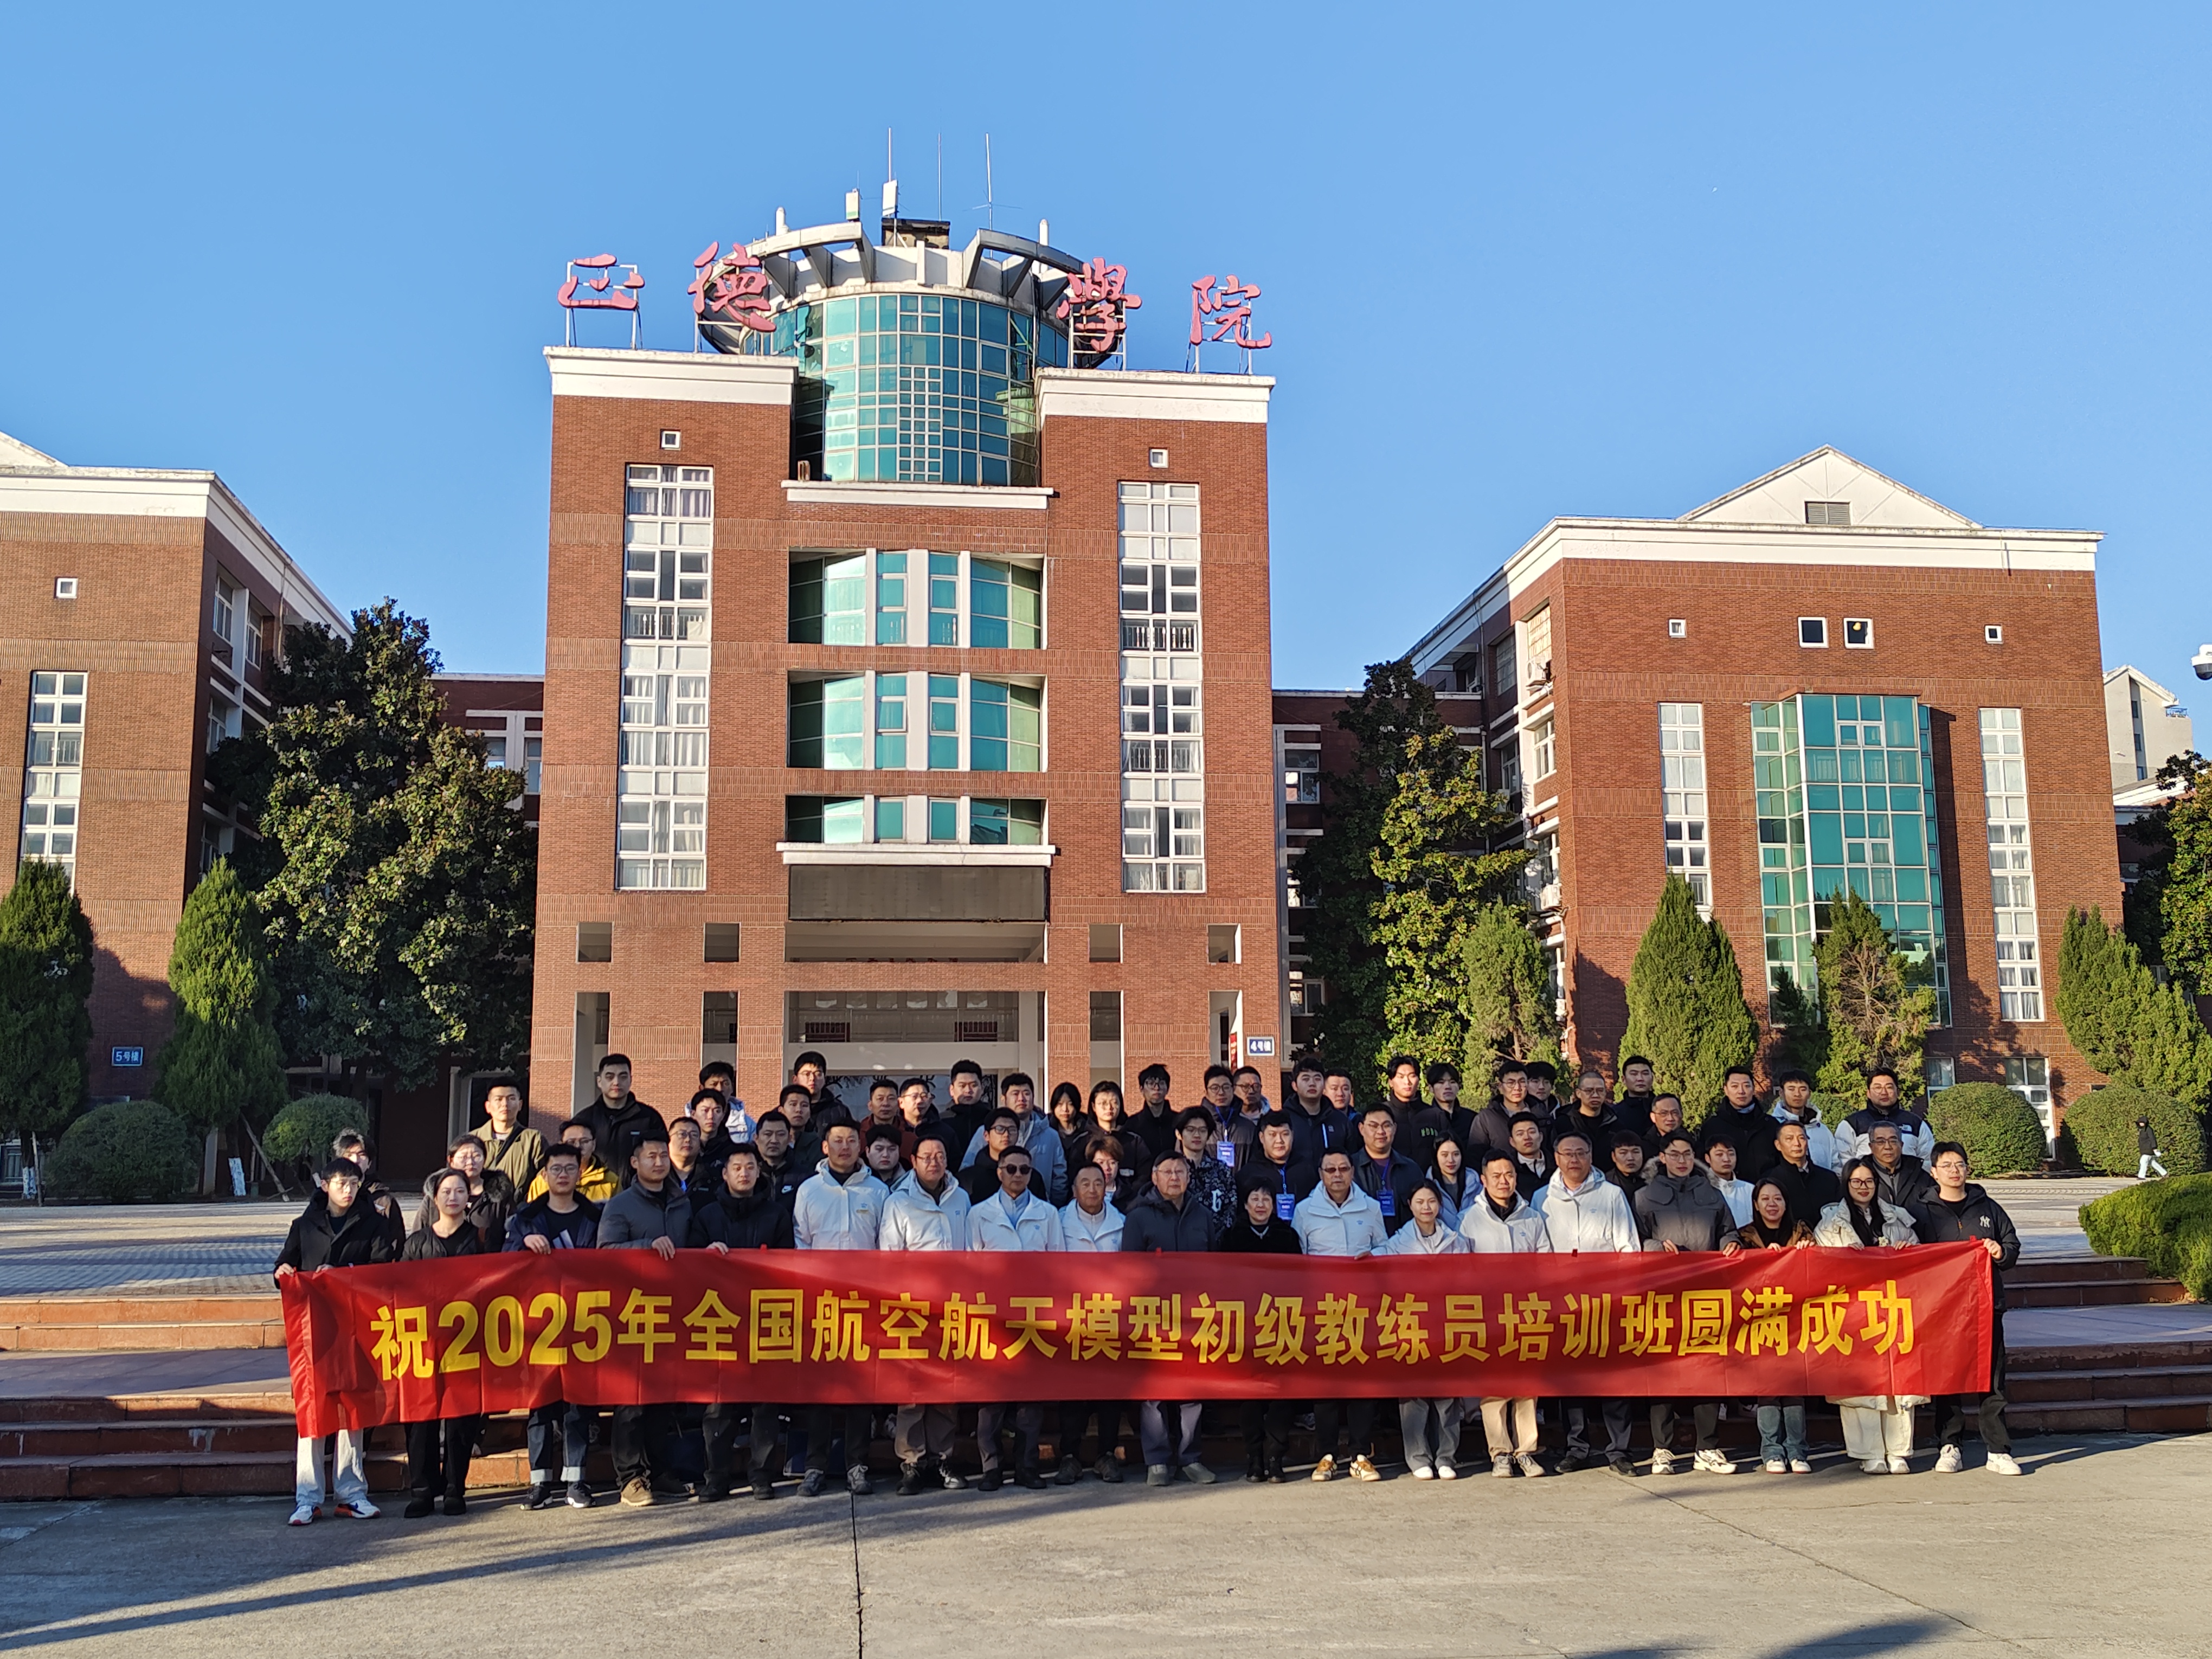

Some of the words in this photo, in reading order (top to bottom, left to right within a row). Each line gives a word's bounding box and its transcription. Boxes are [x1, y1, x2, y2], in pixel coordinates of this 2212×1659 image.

[370, 1279, 1914, 1381] 祝2025年全国航空航天模型初级教练员培训班圆满成功
